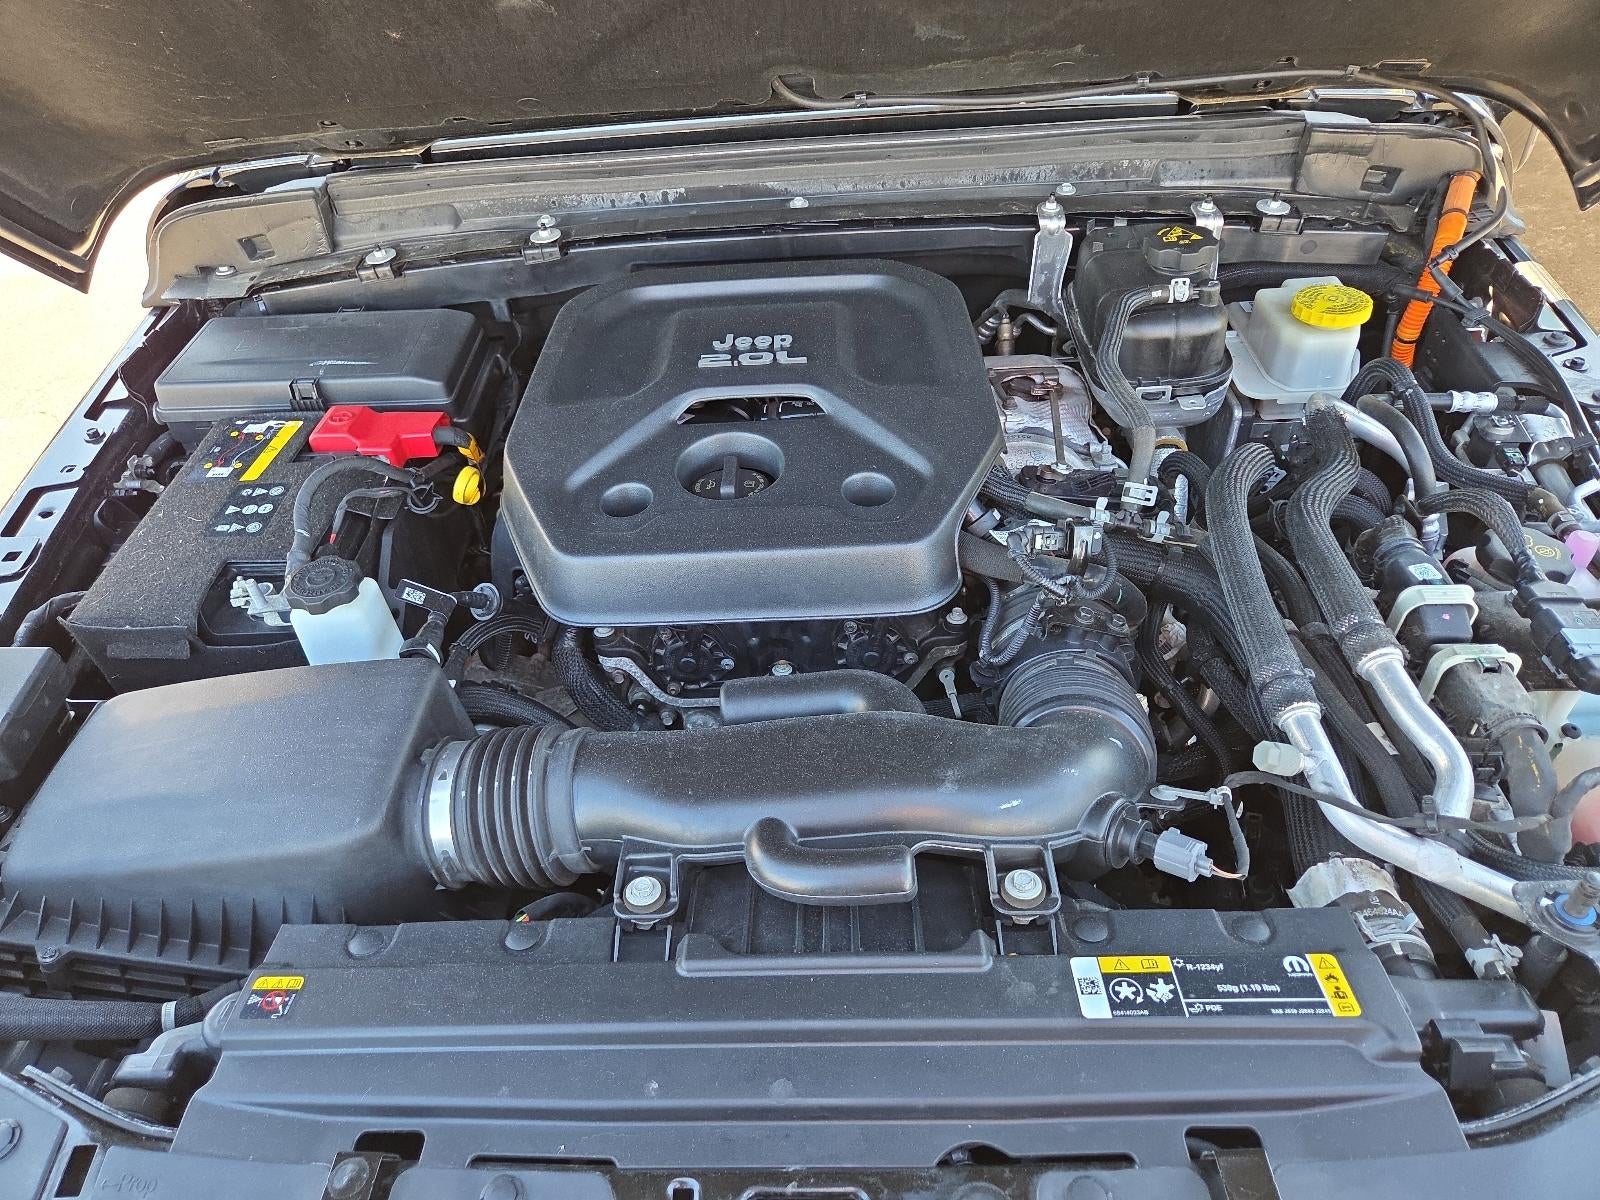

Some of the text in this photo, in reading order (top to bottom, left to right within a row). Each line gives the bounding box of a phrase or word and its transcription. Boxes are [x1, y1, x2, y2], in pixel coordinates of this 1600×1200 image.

[712, 333, 793, 351] Jeep
[698, 351, 808, 368] 2.0L
[1186, 963, 1224, 972] R-1234yf
